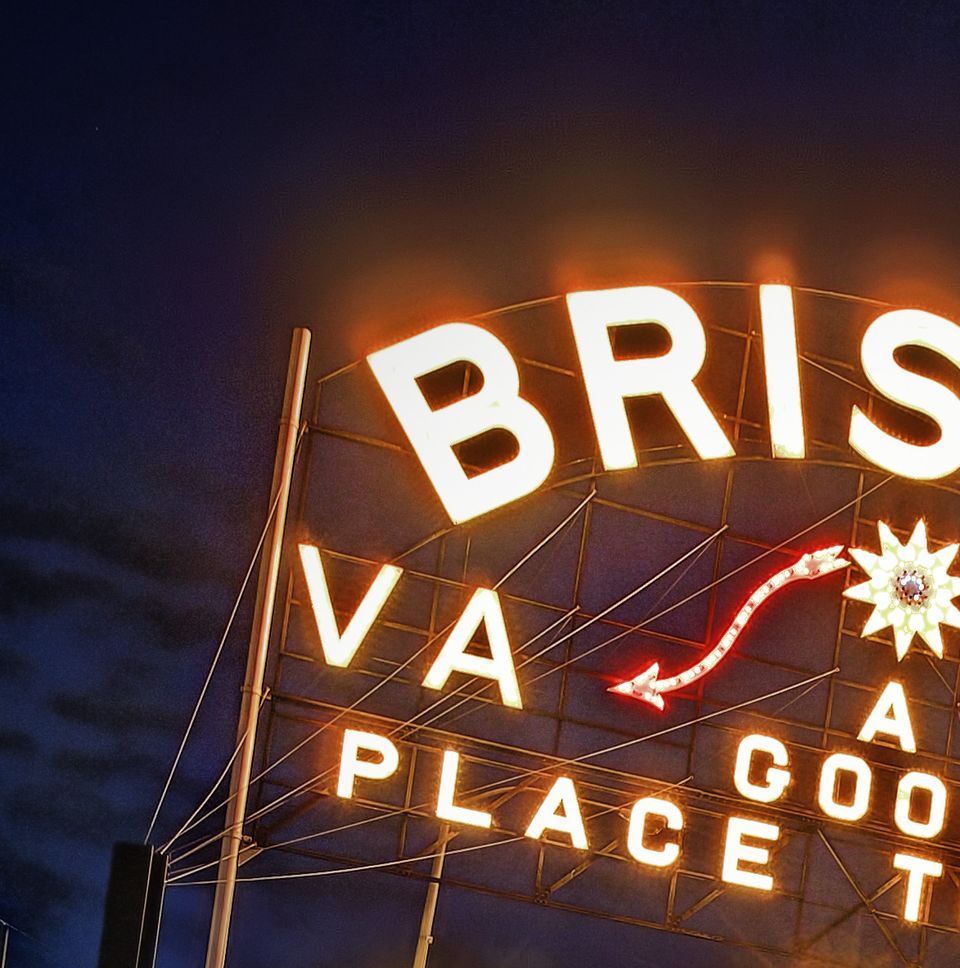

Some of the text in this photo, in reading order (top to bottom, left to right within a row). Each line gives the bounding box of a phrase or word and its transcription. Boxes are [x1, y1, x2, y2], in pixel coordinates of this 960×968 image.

[298, 543, 523, 710] VA
[856, 681, 917, 754] A
[336, 727, 781, 891] PLACE
